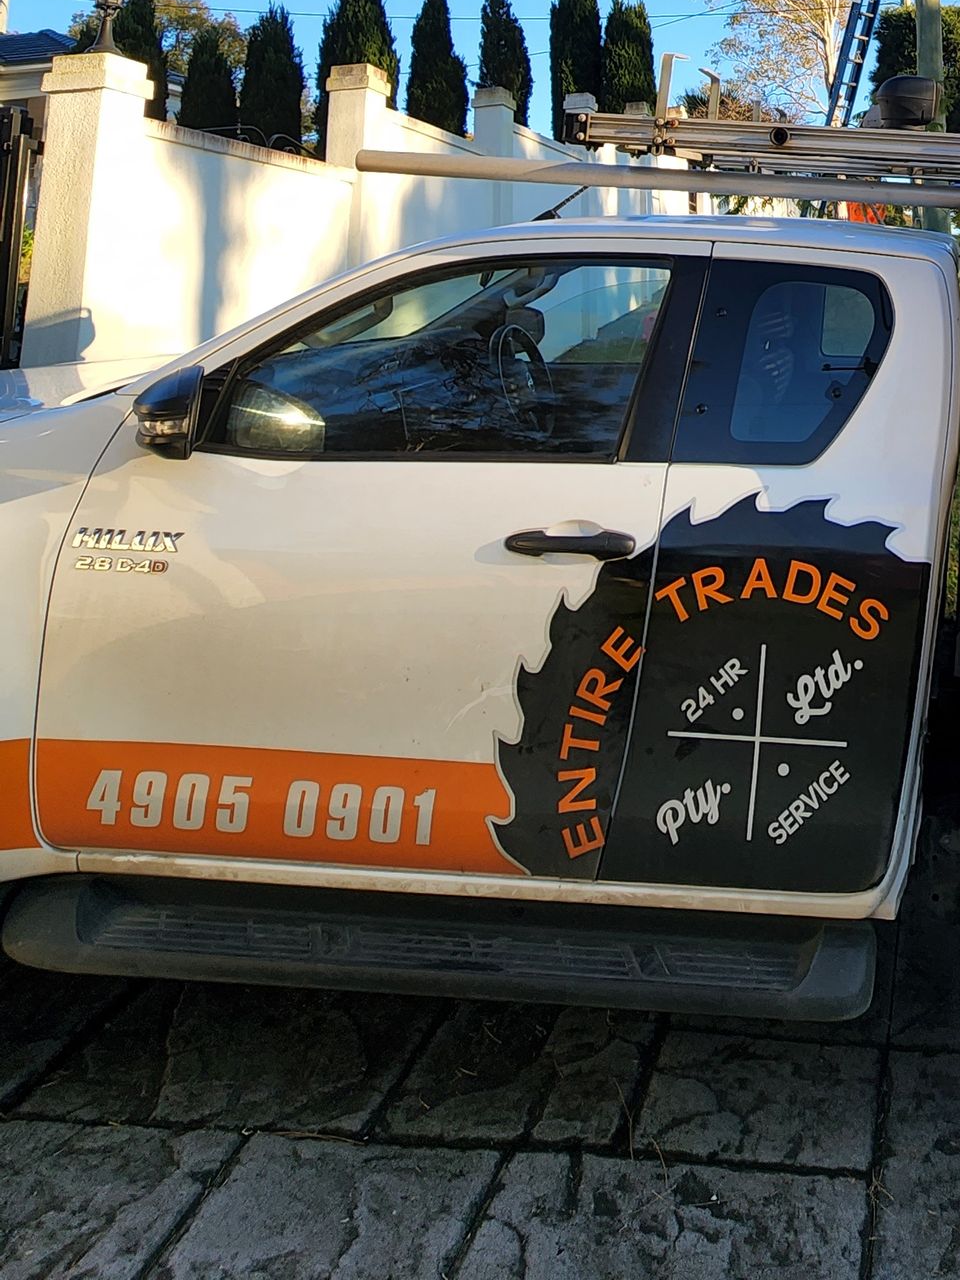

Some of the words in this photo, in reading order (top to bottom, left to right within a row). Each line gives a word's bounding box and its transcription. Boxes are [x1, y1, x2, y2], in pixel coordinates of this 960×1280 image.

[71, 527, 184, 552] HILUX
[75, 555, 112, 570] 2.8
[116, 557, 168, 575] D-4D
[557, 626, 644, 859] ENTIRE
[655, 558, 889, 641] TRADES
[680, 686, 715, 723] 24
[711, 656, 749, 697] HR
[787, 649, 864, 725] Ltd.
[86, 769, 254, 833] 4905
[283, 780, 436, 846] 0901
[656, 778, 731, 846] Pty.
[767, 760, 850, 846] SERVICE
